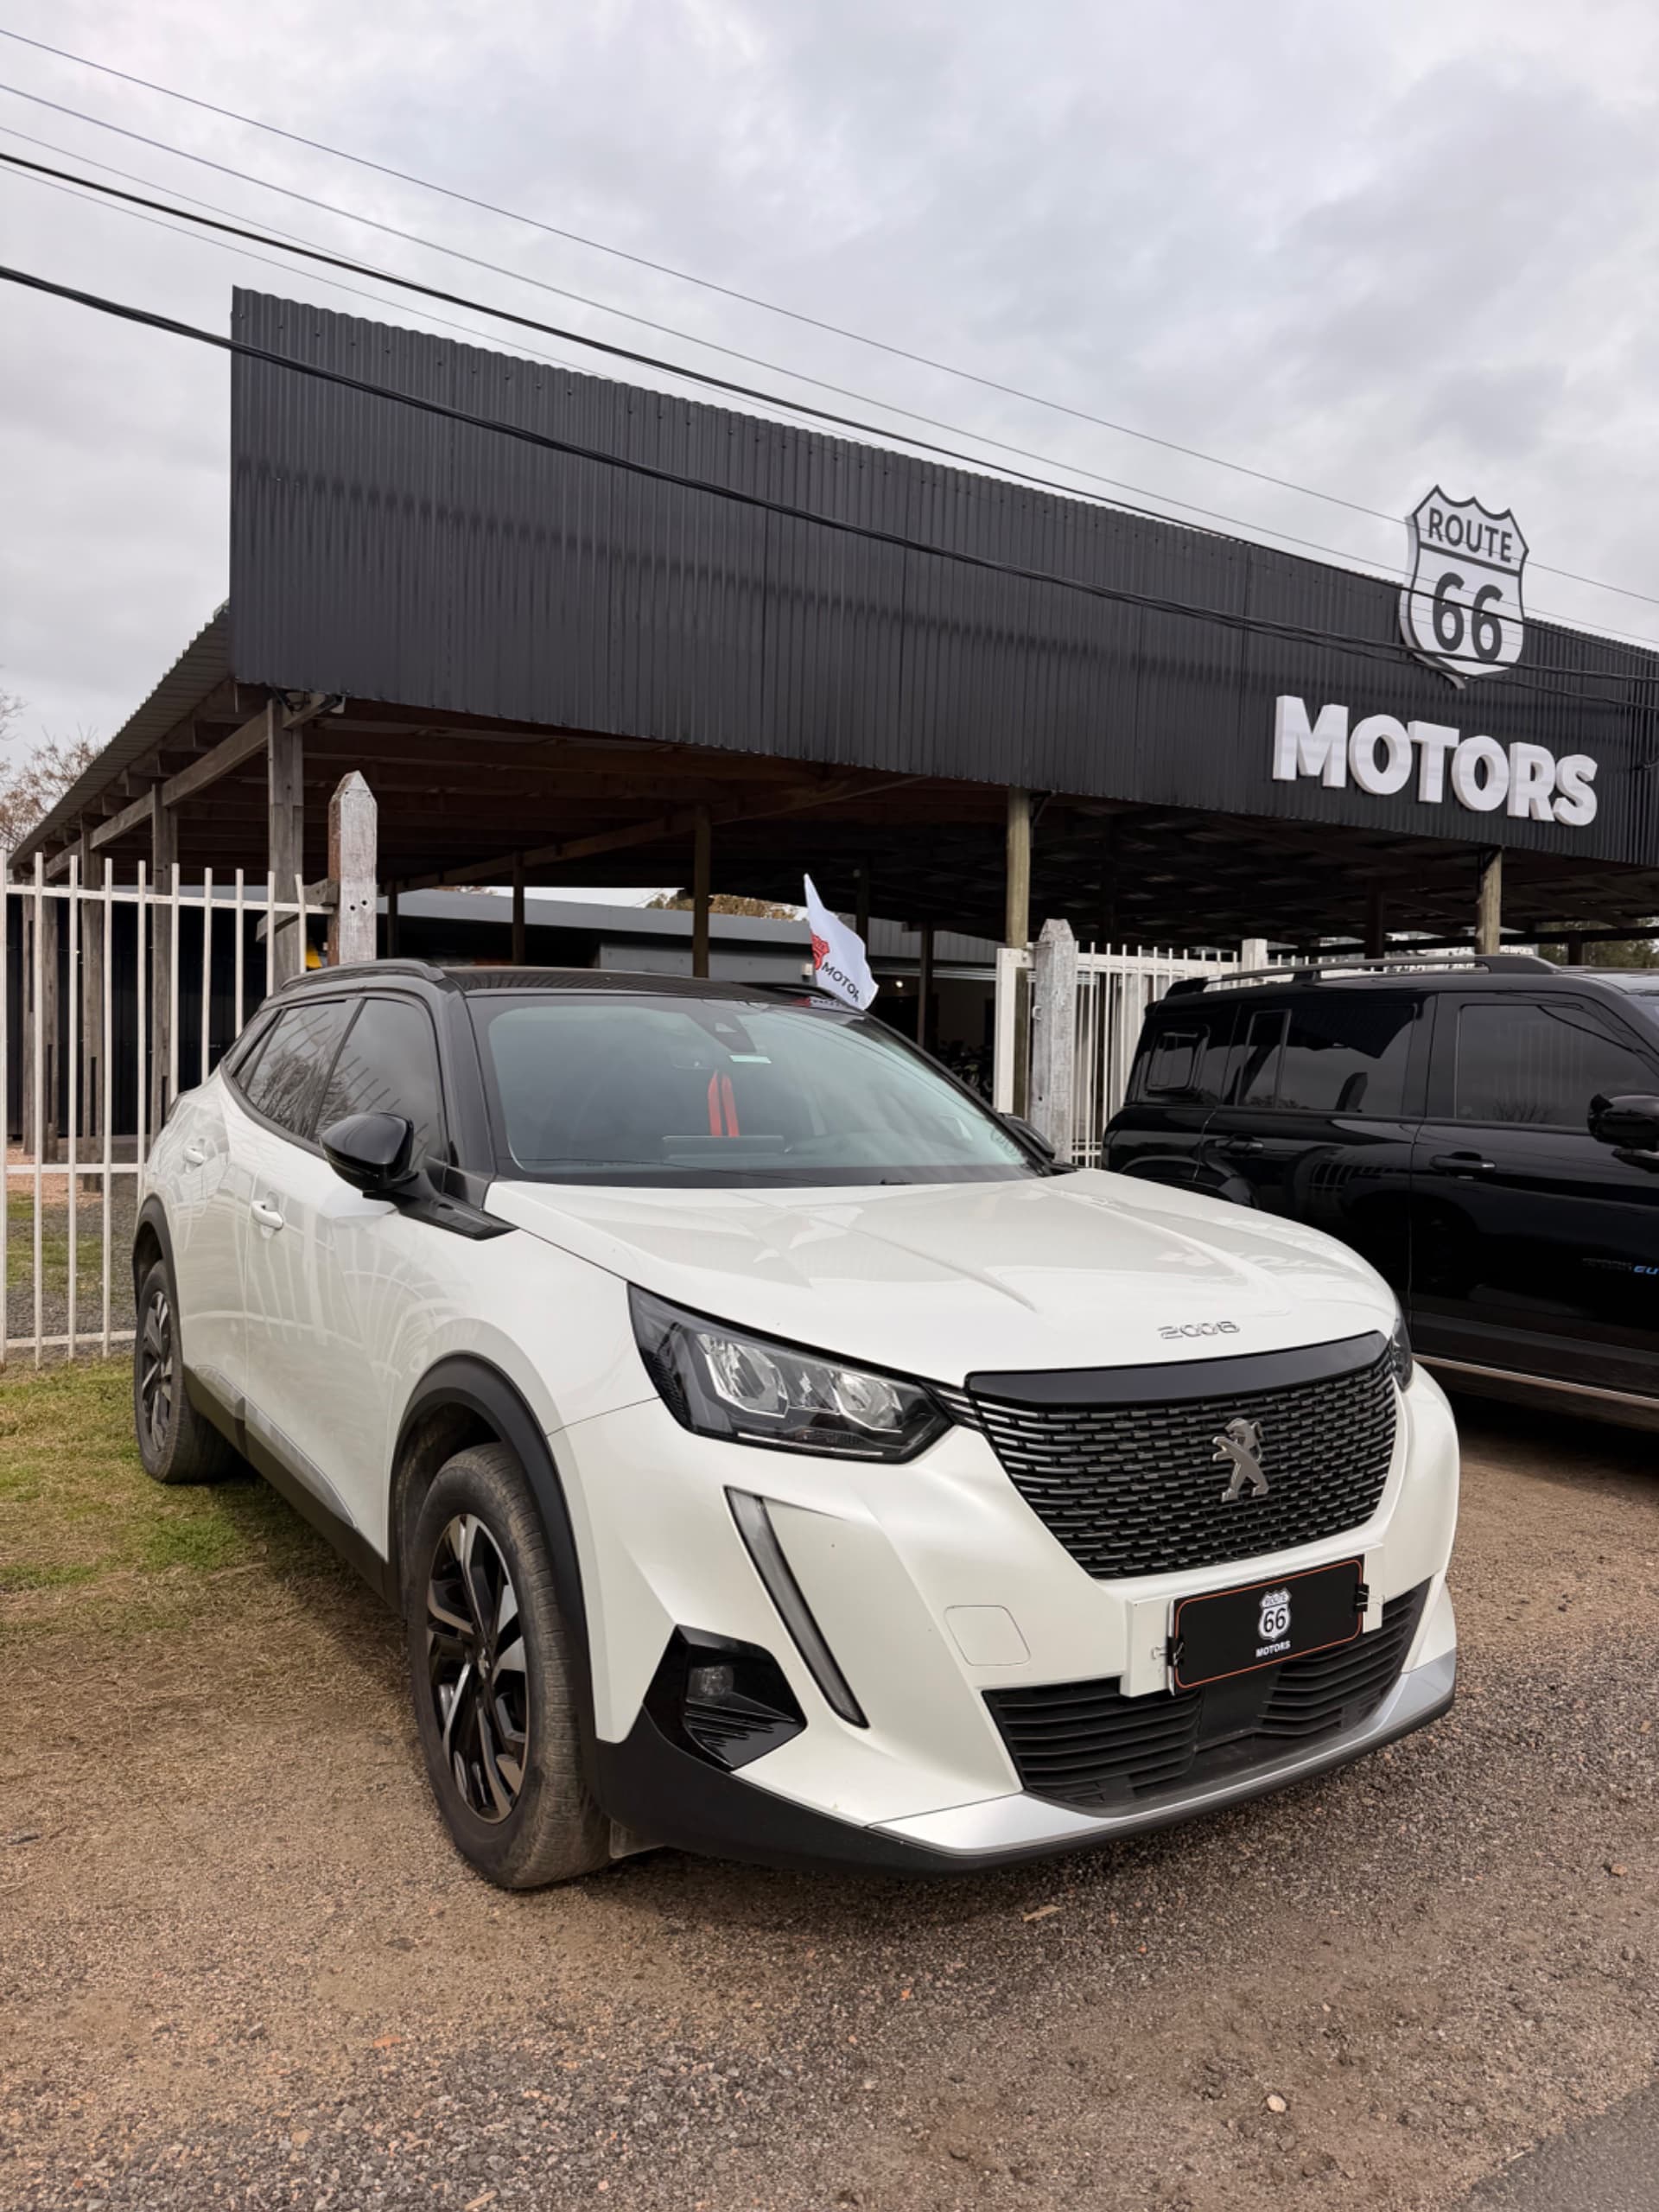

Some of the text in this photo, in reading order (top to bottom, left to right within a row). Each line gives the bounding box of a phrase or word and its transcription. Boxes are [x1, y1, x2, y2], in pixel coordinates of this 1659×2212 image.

[1427, 506, 1513, 563] ROUTE
[1432, 571, 1503, 662] 66
[1272, 695, 1599, 828] MOTORS
[1158, 1320, 1240, 1340] 2008
[1263, 1607, 1287, 1632] 66
[1255, 1641, 1291, 1658] MOTORS
